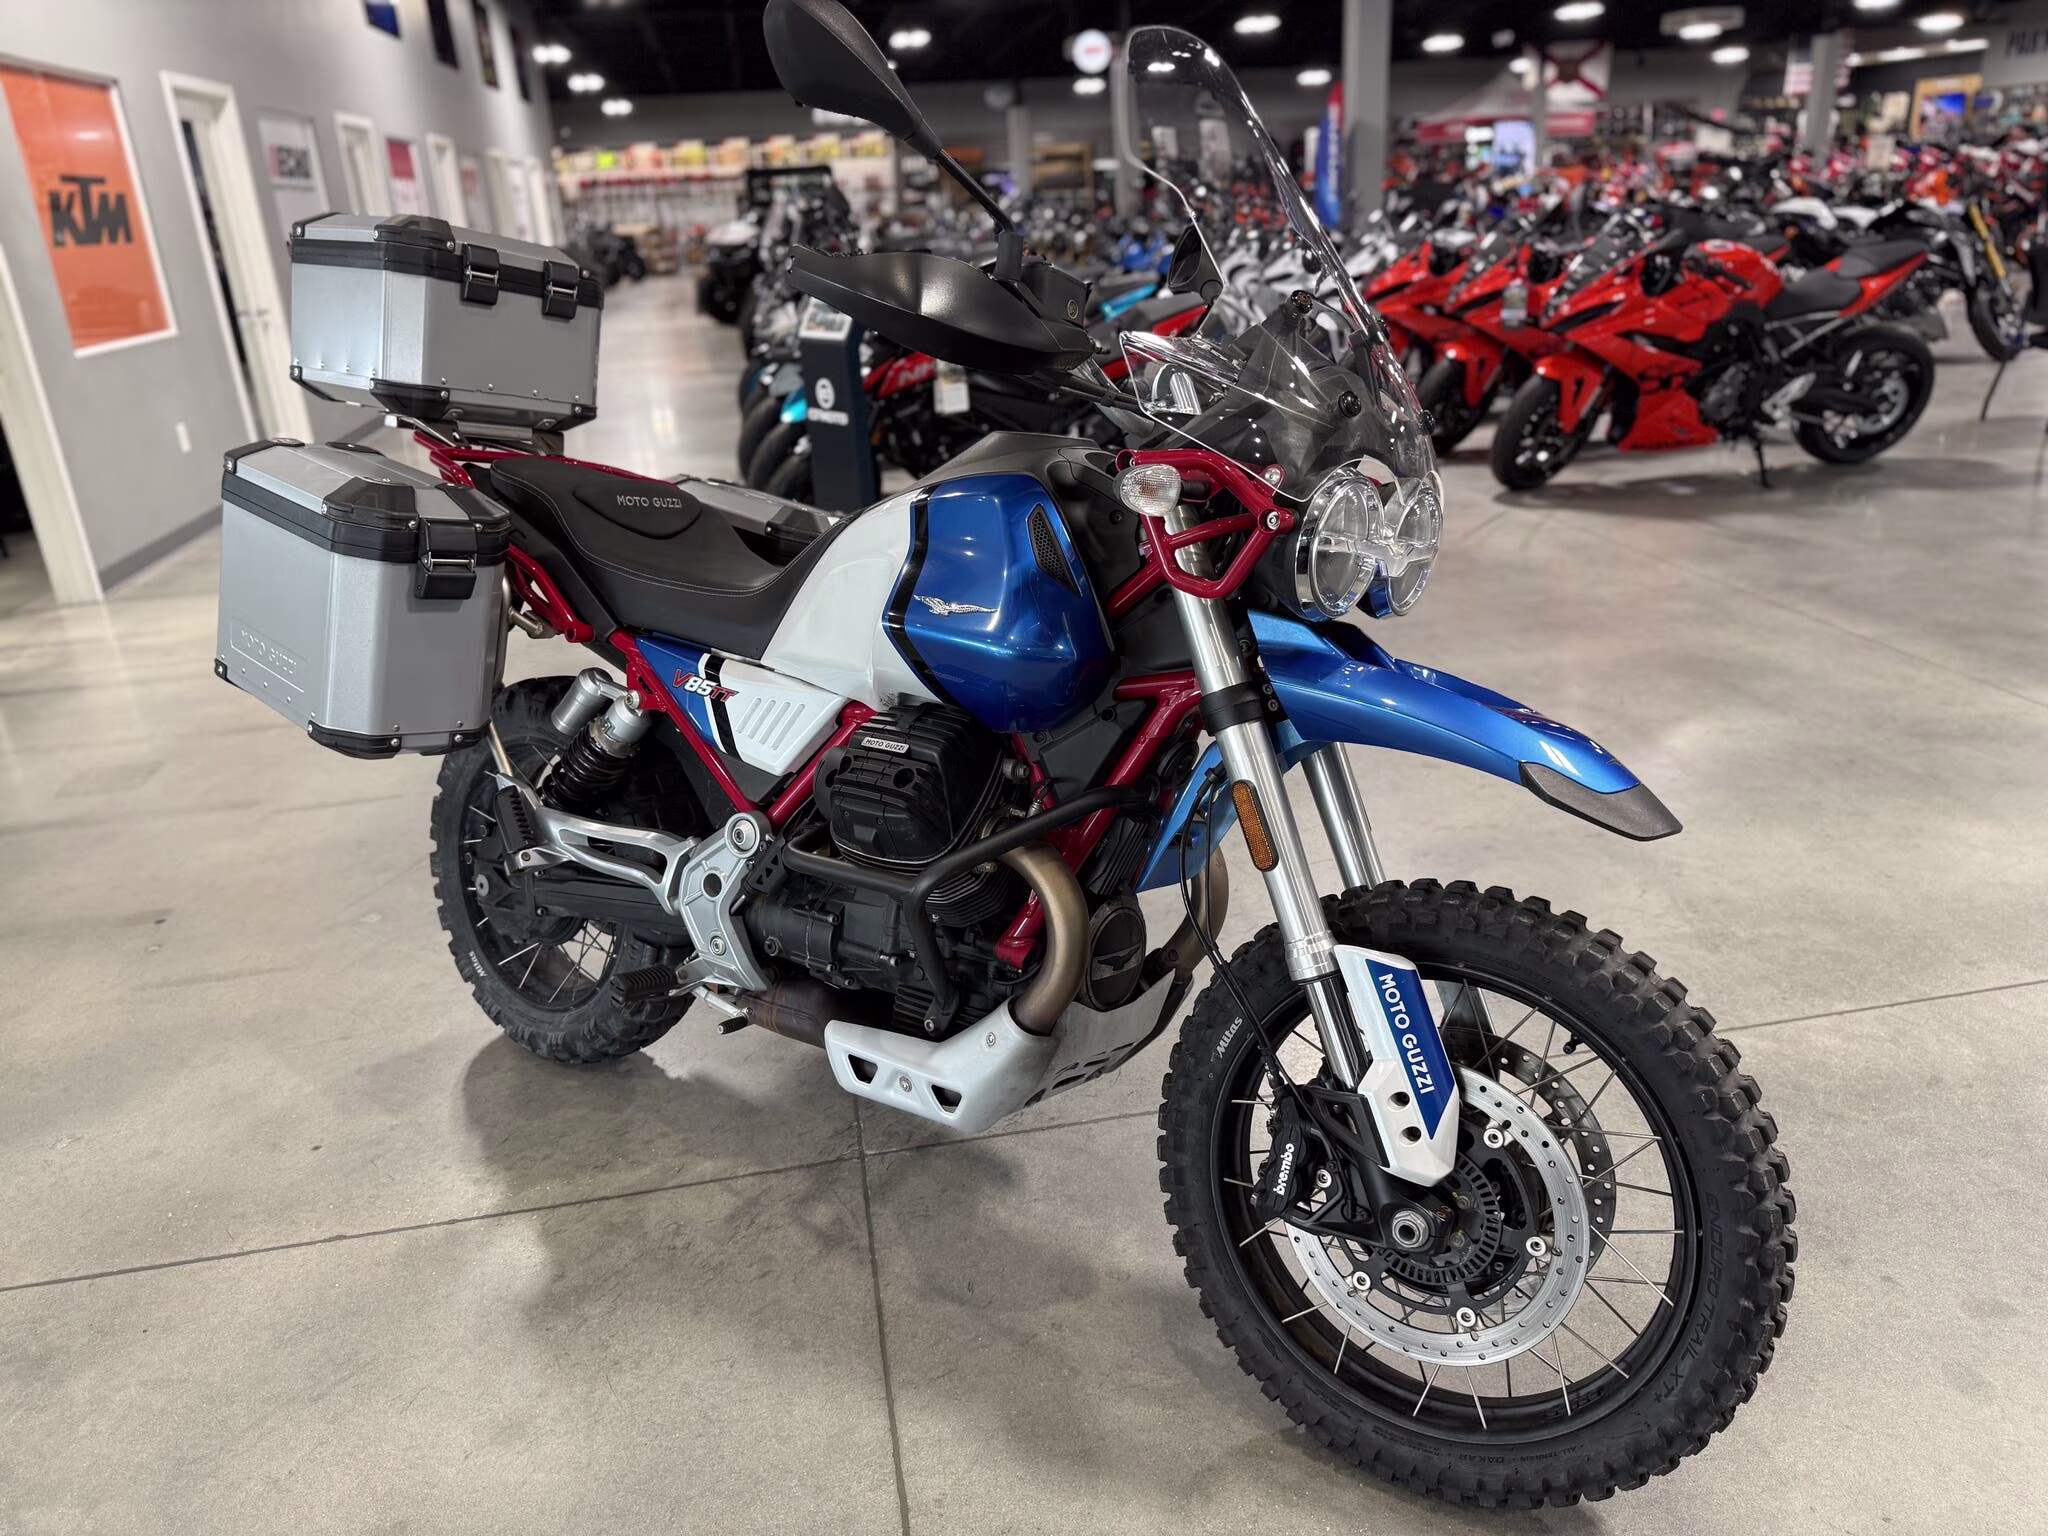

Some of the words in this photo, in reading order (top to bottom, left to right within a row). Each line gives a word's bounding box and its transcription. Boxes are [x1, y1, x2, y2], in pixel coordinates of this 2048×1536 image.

[49, 175, 133, 247] KTM
[617, 495, 650, 507] MOTO
[652, 497, 682, 508] GUZZI
[673, 668, 739, 703] V85TT
[865, 739, 884, 747] MOTO
[884, 742, 906, 751] GUZZI
[468, 950, 488, 977] Mitas
[1216, 1016, 1243, 1059] Mitas
[1378, 973, 1411, 1030] MOTO
[1401, 1033, 1436, 1094] GUZZI
[1273, 1143, 1295, 1196] brembo
[1706, 1192, 1724, 1299] ENDURO
[1681, 1303, 1716, 1361] TRAIL
[1457, 1454, 1505, 1464] DAKAR
